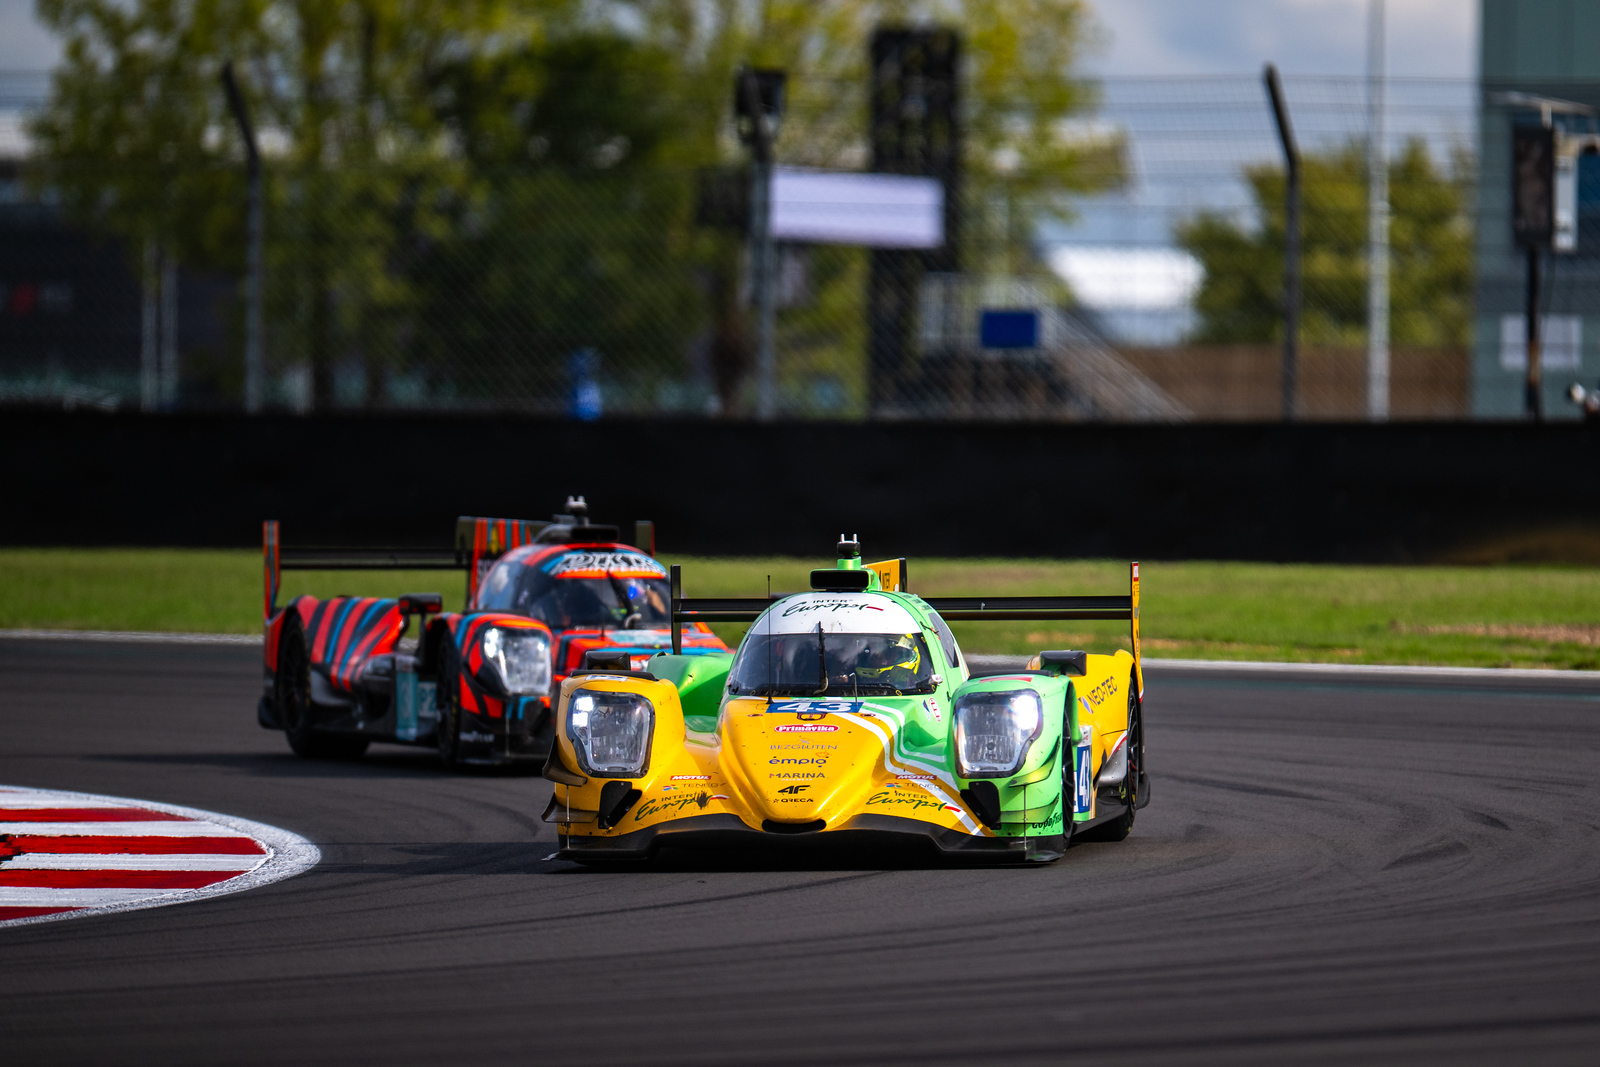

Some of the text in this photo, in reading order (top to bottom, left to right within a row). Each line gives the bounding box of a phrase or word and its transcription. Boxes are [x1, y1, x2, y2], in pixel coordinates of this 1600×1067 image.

[782, 601, 869, 617] Europol
[1087, 676, 1118, 707] NEO-TEC
[777, 702, 852, 712] 43
[1079, 749, 1090, 807] 43
[778, 785, 810, 794] 4F
[895, 791, 928, 799] INTER
[866, 792, 948, 811] Europol
